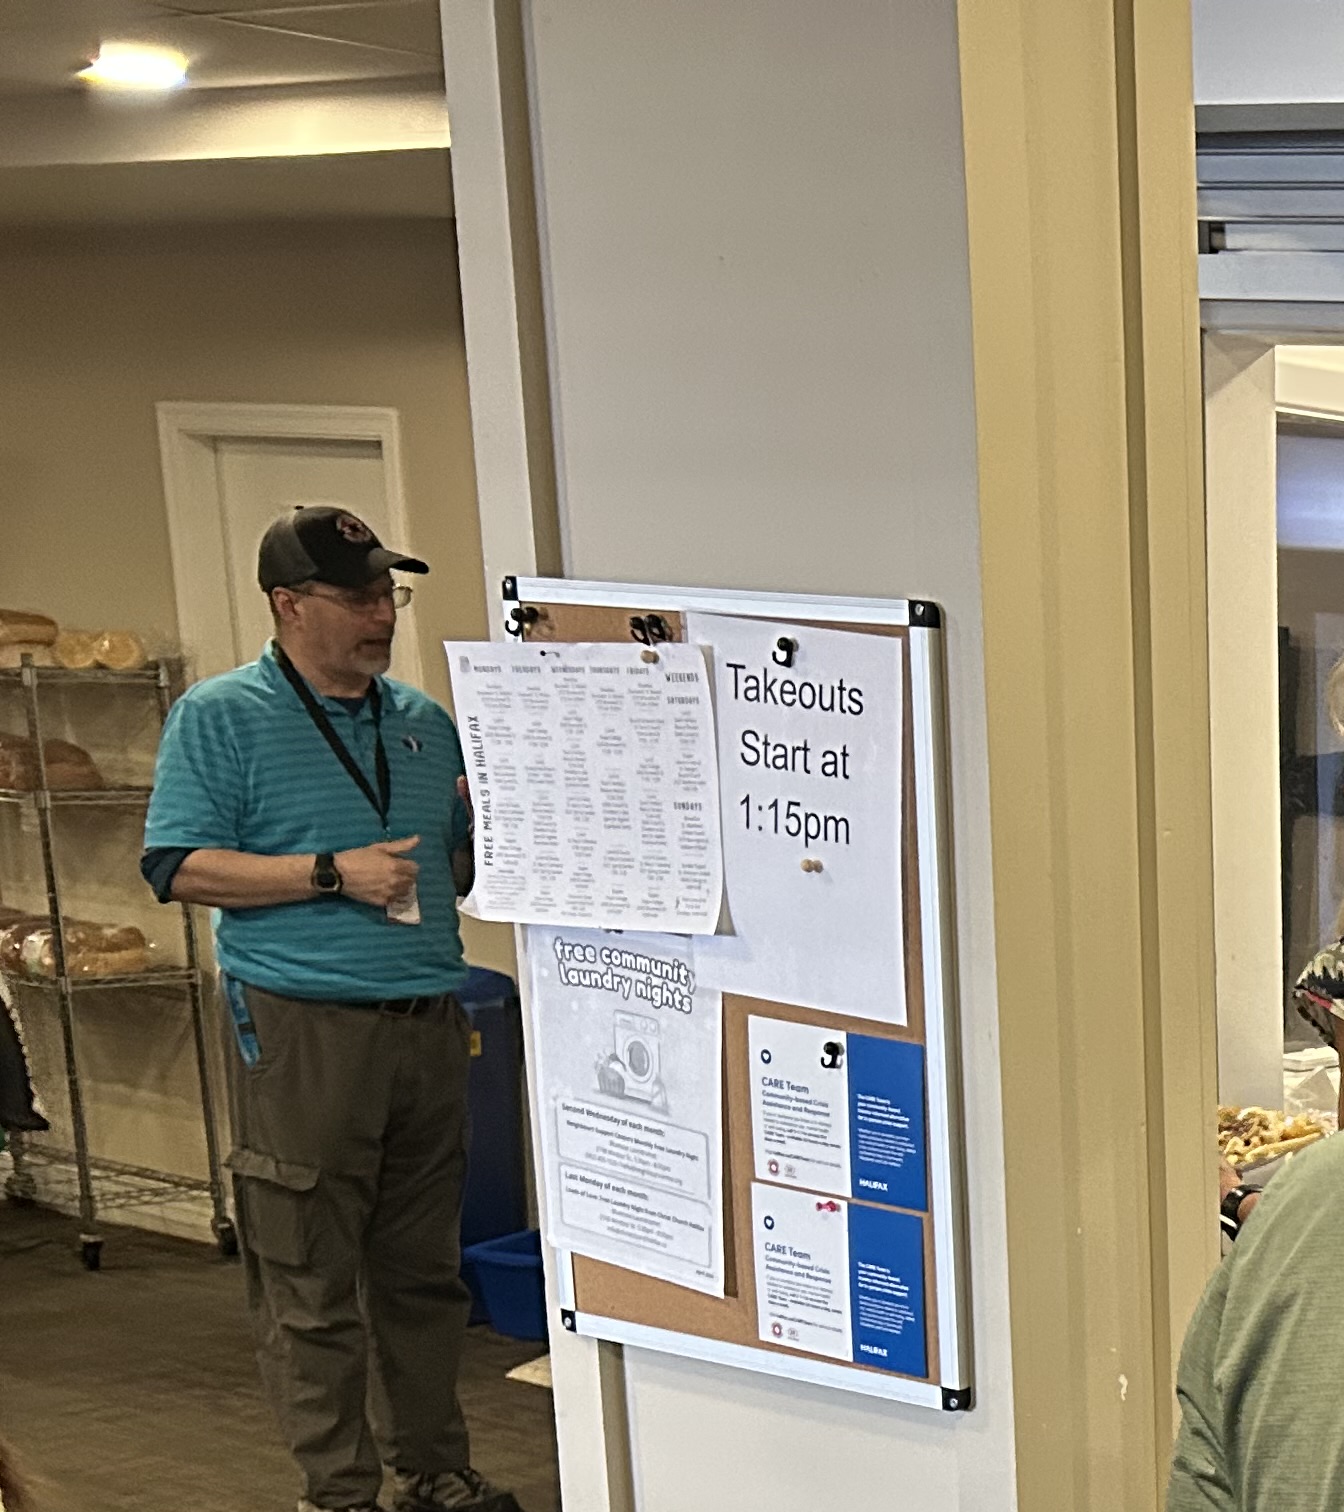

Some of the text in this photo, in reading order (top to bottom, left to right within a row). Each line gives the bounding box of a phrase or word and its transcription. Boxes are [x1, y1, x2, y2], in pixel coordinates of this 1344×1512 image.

[726, 663, 864, 716] Takeouts
[740, 729, 850, 779] Start at
[467, 716, 493, 866] FREE MEALS IN HALIFAX
[740, 794, 850, 848] 1:15pm
[553, 935, 696, 994] free community
[558, 961, 692, 1015] laundry nights
[762, 1077, 809, 1094] CARE Team
[765, 1242, 811, 1260] CARE Team
